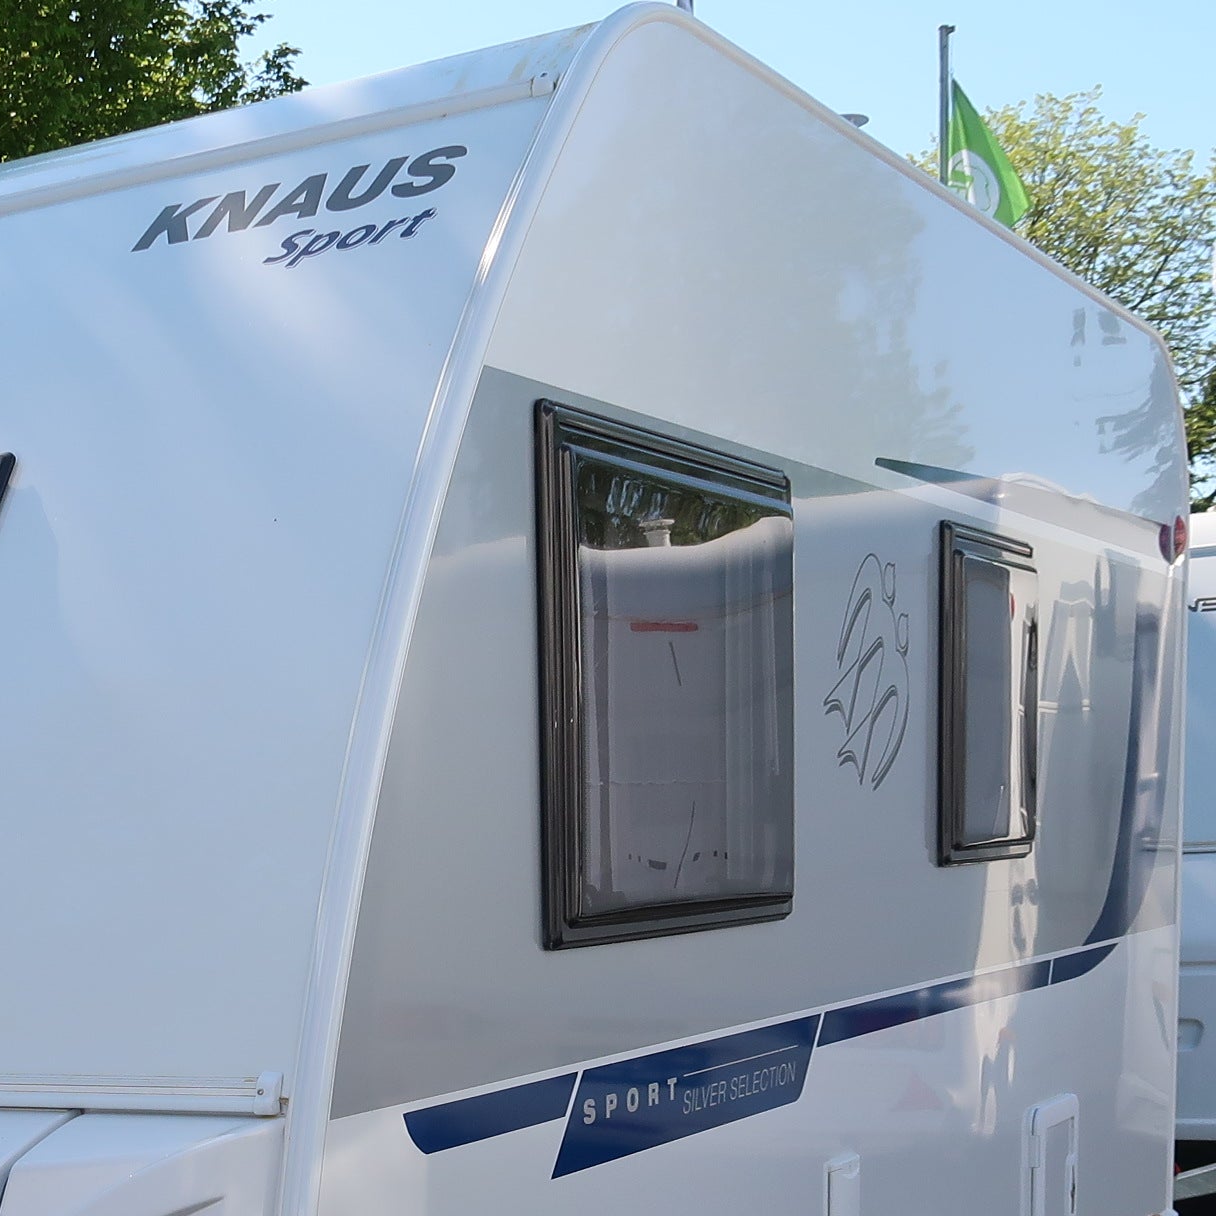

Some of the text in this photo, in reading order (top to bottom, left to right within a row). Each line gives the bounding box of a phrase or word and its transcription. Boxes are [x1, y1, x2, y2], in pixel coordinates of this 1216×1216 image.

[131, 145, 468, 252] KNAUS
[262, 207, 437, 269] Sport
[583, 1061, 796, 1124] SPORT SILVER SELECTION
